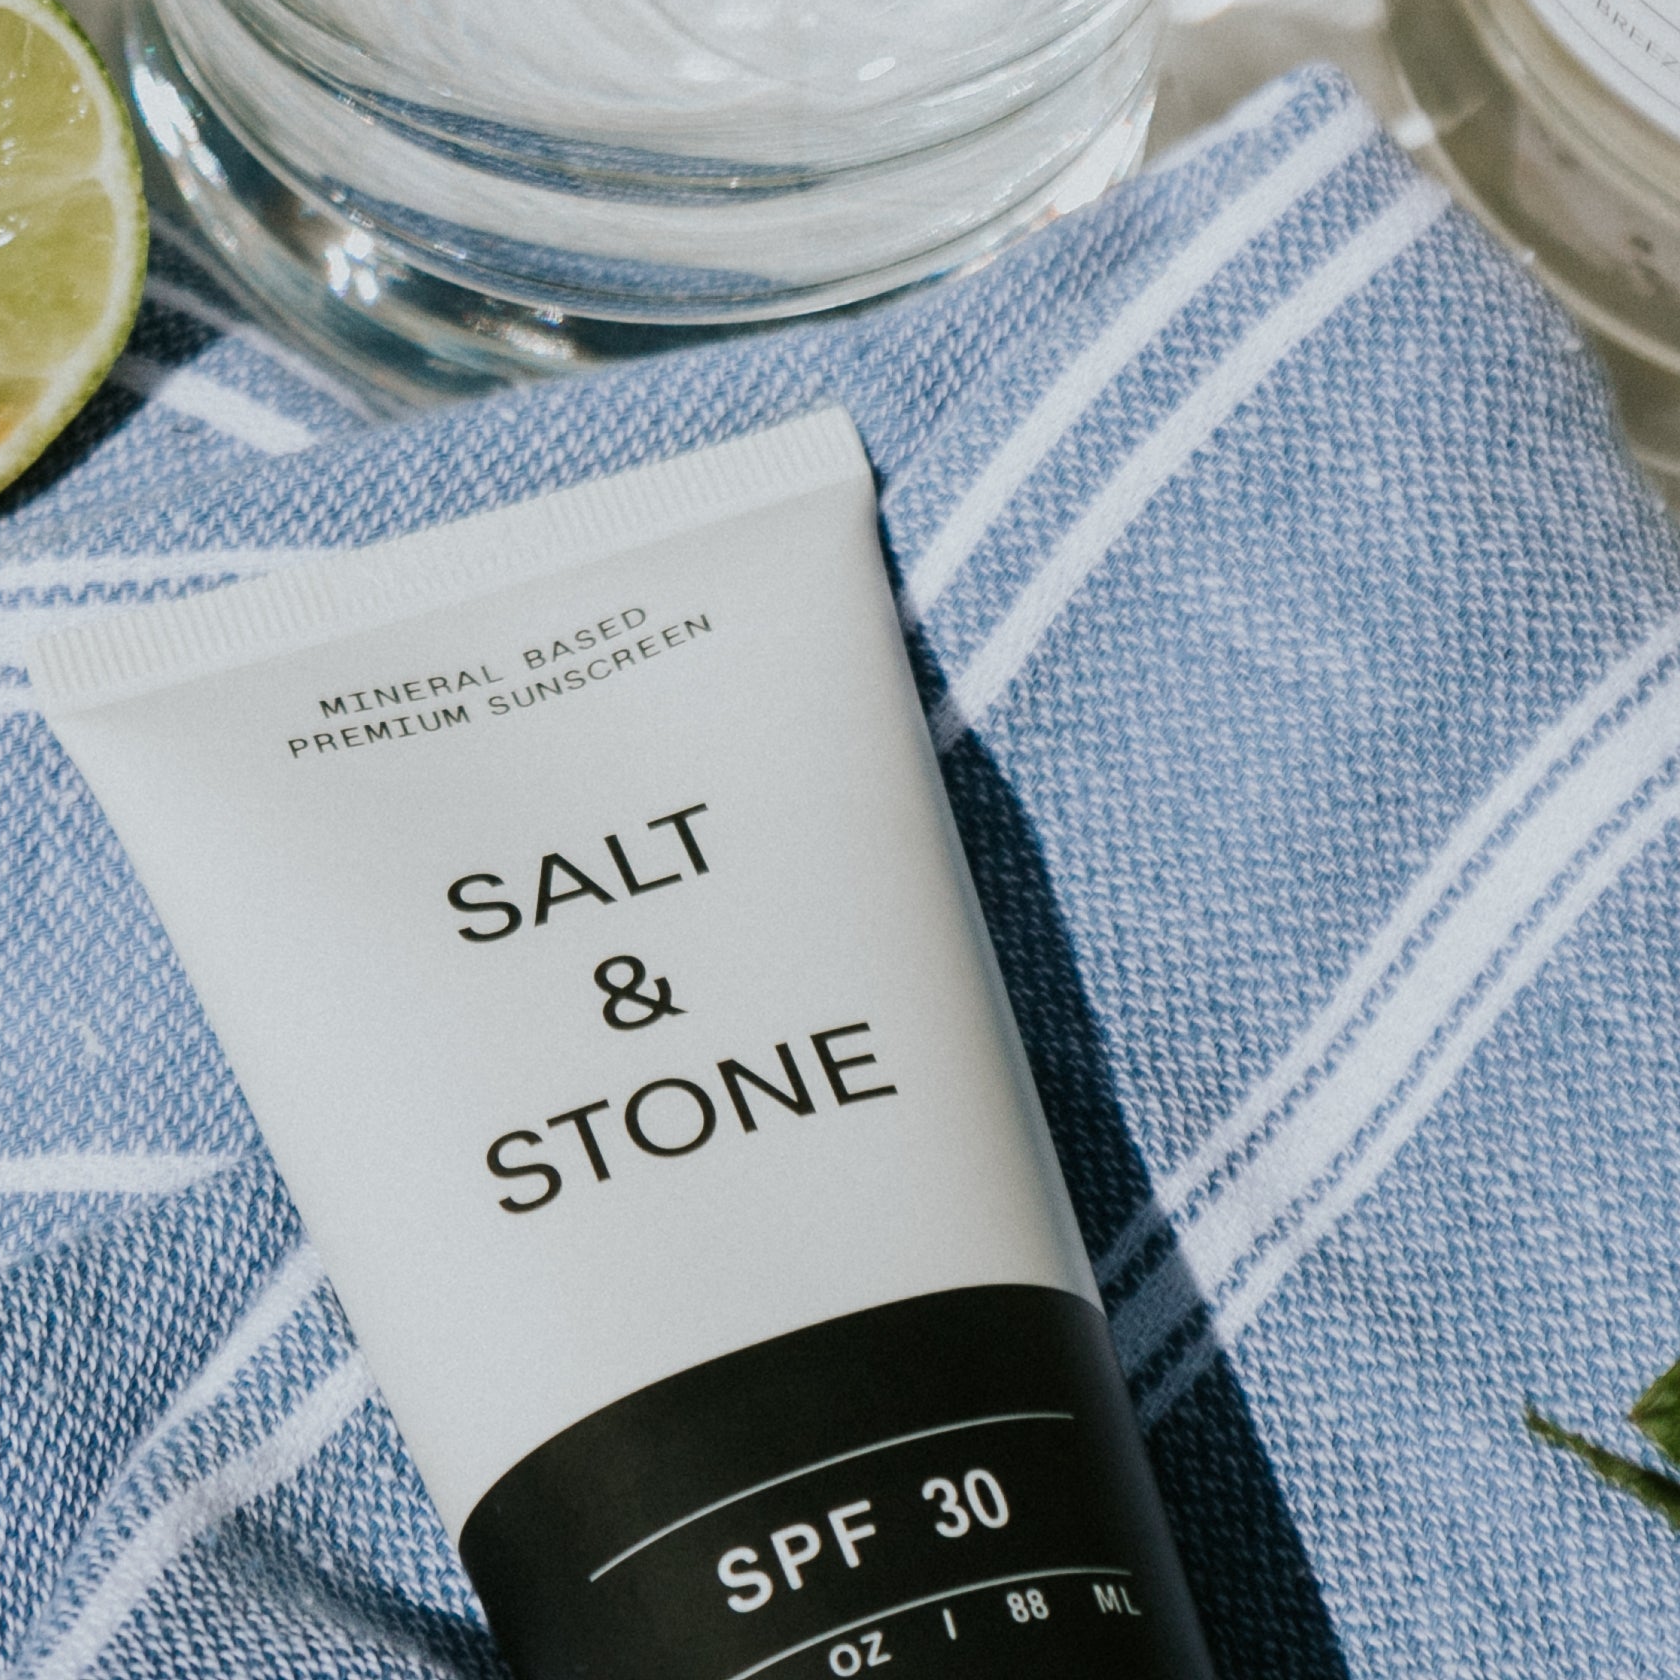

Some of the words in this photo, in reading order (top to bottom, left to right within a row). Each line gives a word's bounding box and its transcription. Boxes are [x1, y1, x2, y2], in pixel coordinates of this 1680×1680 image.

[287, 704, 472, 760] PREMIUM
[487, 613, 713, 717] SUNSCREEN
[318, 665, 504, 720] MINERAL
[522, 607, 647, 670] BASED
[446, 802, 711, 943] SALT
[591, 954, 688, 1032] &
[484, 1021, 900, 1215] STONE
[717, 1499, 876, 1613] SPF
[921, 1468, 1010, 1538] 30
[828, 1630, 892, 1678] OZ
[1006, 1587, 1050, 1623] 88
[1092, 1584, 1141, 1616] ML
